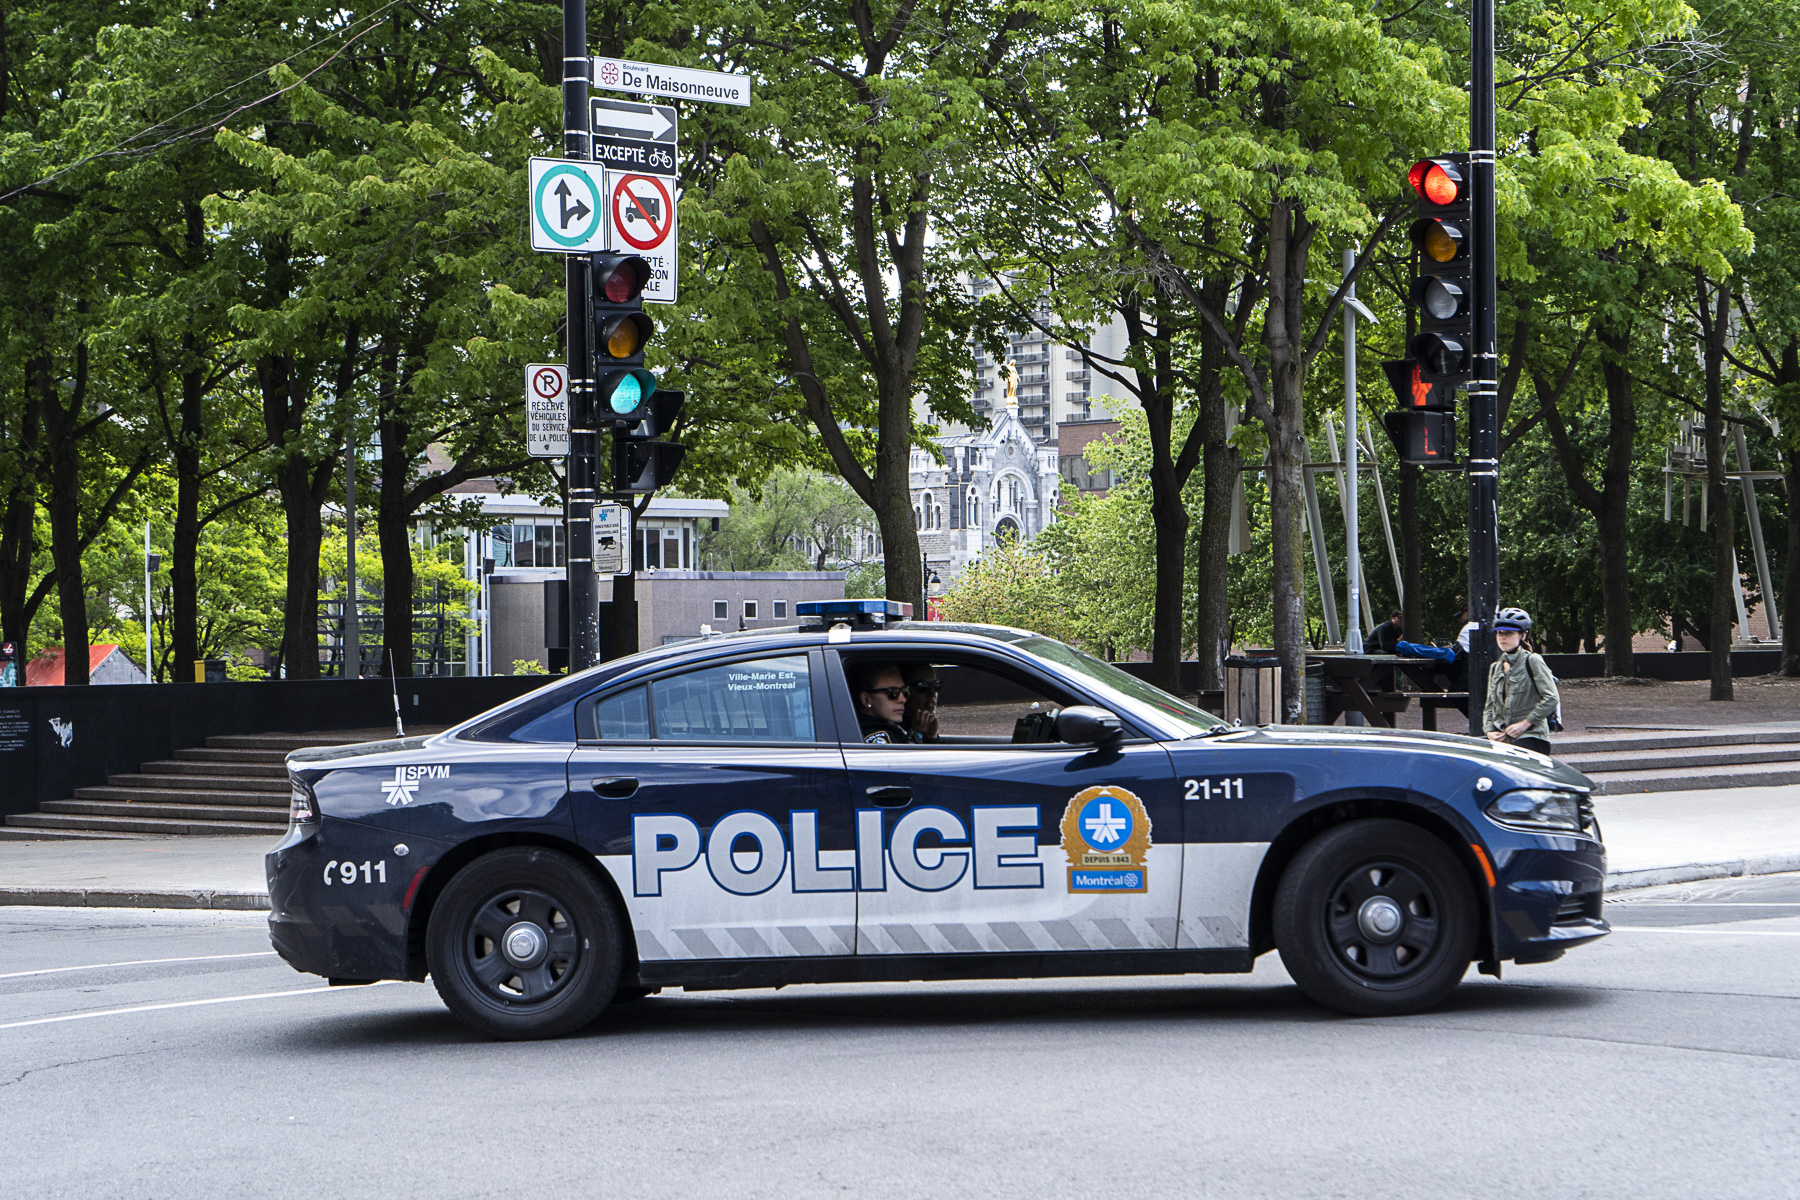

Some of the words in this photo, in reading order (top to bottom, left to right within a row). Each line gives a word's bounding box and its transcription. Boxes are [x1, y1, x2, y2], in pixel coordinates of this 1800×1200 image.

[622, 63, 649, 73] Boulevard
[622, 71, 642, 88] De
[646, 74, 740, 100] Maisonneuve
[595, 143, 646, 164] EXCEPTÉ
[531, 400, 565, 411] RÉSERVÉ
[530, 411, 567, 421] VÉHICULES
[532, 423, 540, 432] DU
[542, 423, 566, 432] SERVICE
[529, 433, 537, 442] DE
[539, 433, 547, 442] LA
[549, 433, 568, 443] POLICE
[728, 672, 777, 681] Ville-Marie
[778, 671, 796, 680] Est,
[406, 765, 451, 780] SPVM
[1184, 777, 1244, 801] 21-11
[631, 804, 1044, 897] POLICE
[1084, 855, 1110, 864] DEPUIS
[1112, 855, 1130, 864] 1843
[340, 860, 387, 885] 911
[1076, 874, 1124, 886] Montréal
